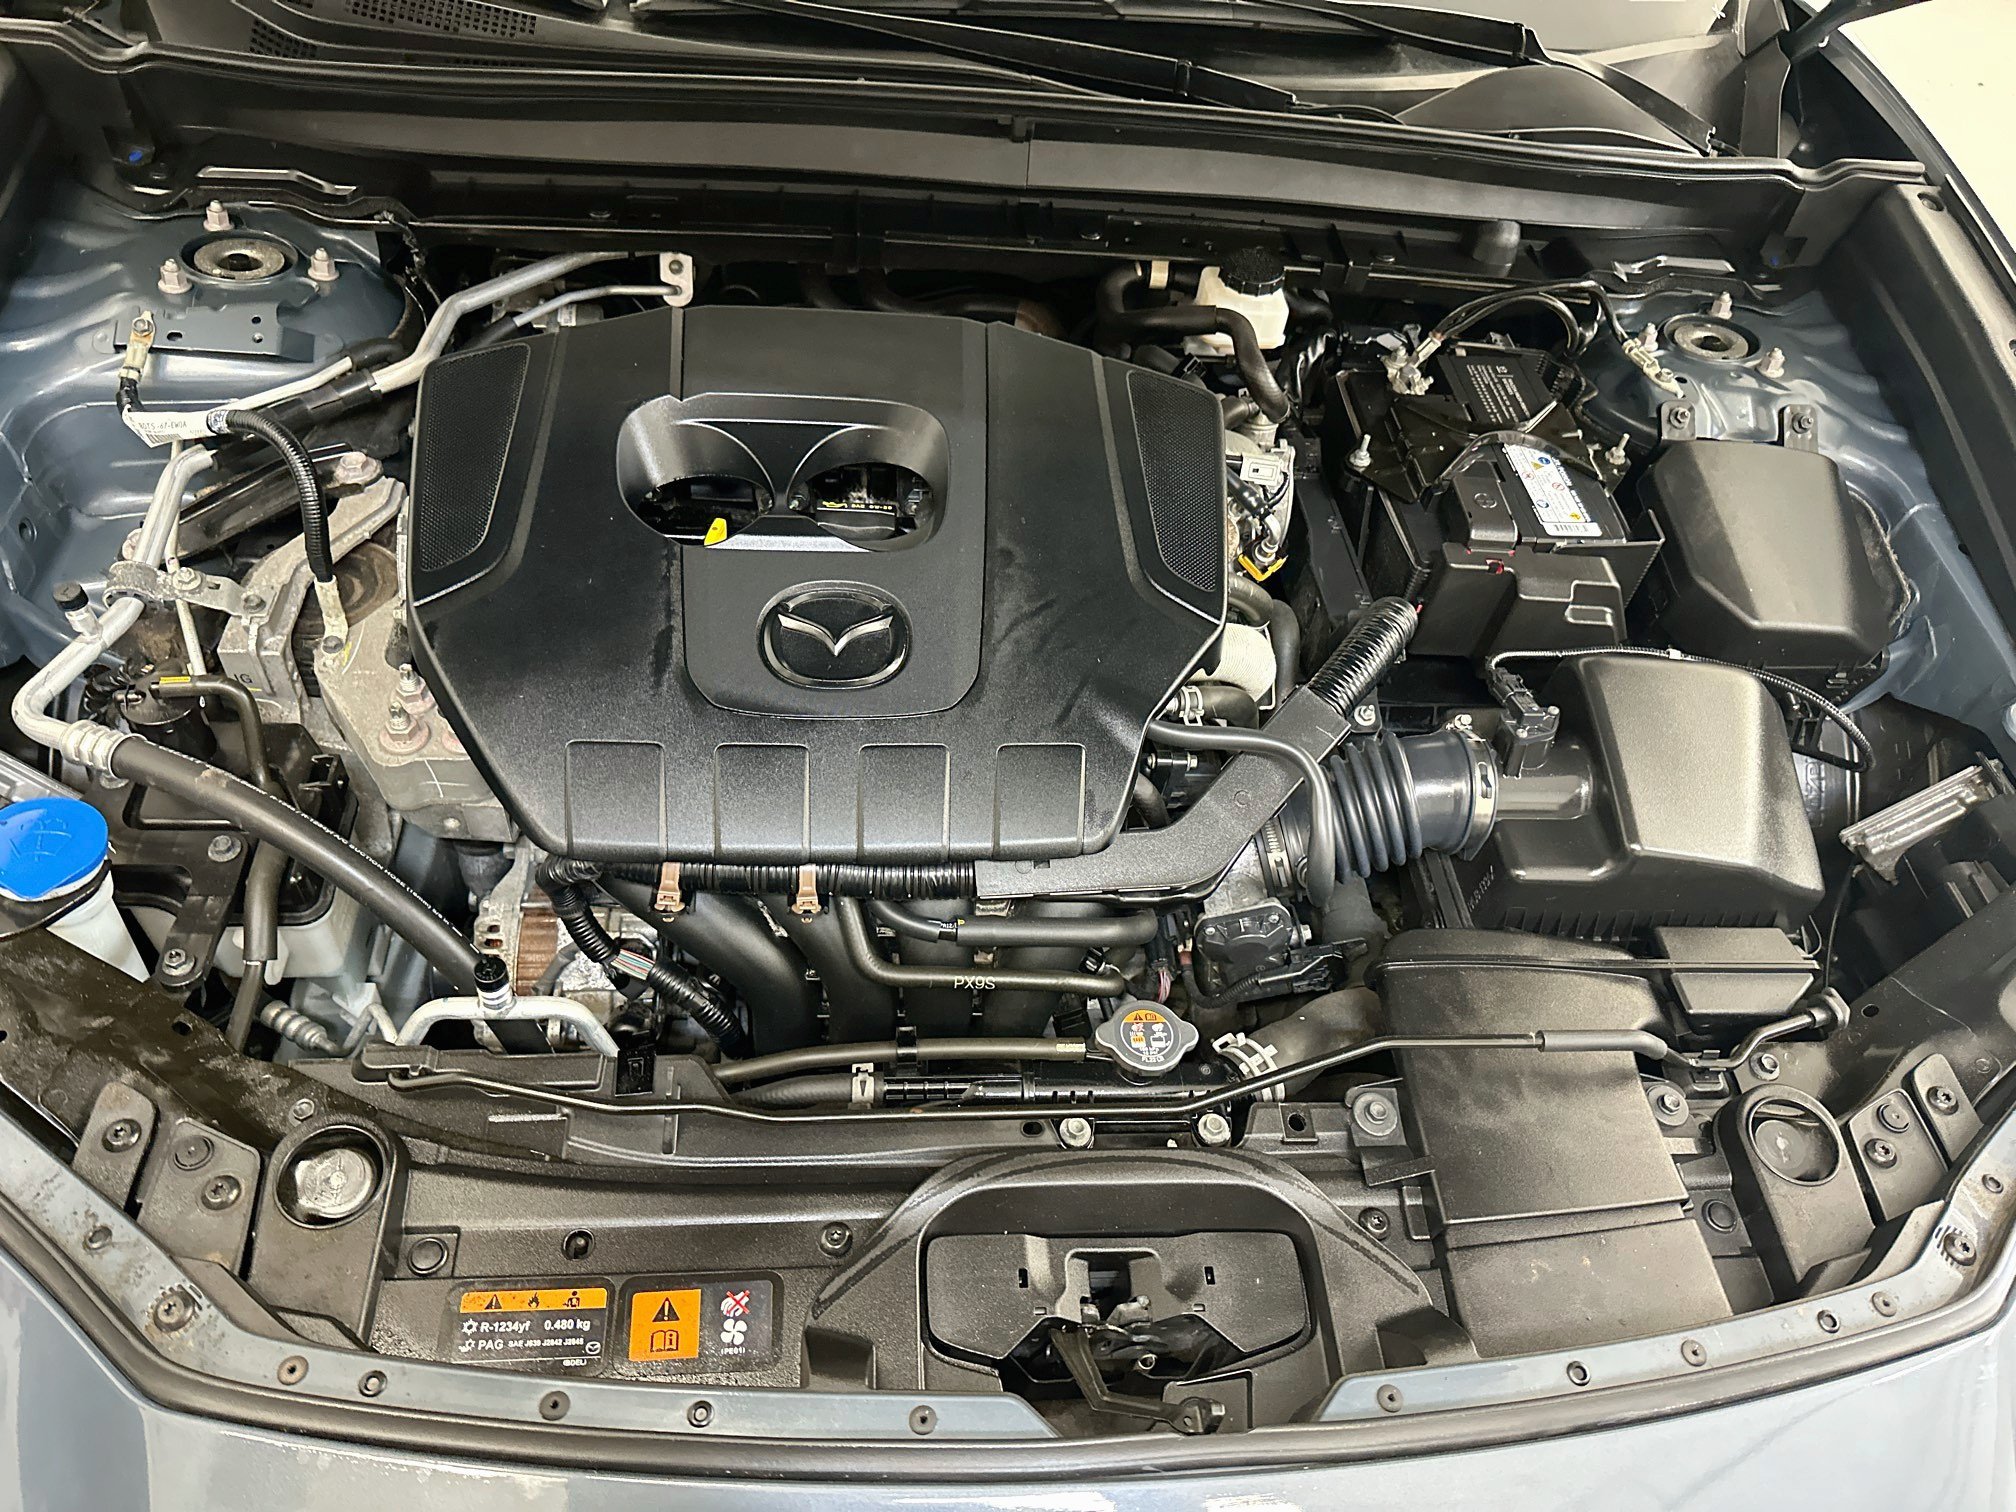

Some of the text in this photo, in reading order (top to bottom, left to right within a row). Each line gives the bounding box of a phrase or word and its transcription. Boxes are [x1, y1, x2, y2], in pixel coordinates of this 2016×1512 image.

[348, 843, 383, 870] SUCTION
[384, 868, 406, 888] HOSE
[953, 975, 996, 990] PX9S
[480, 1318, 591, 1334] R-1234yf 0.480 kg
[478, 1338, 504, 1351] PAG
